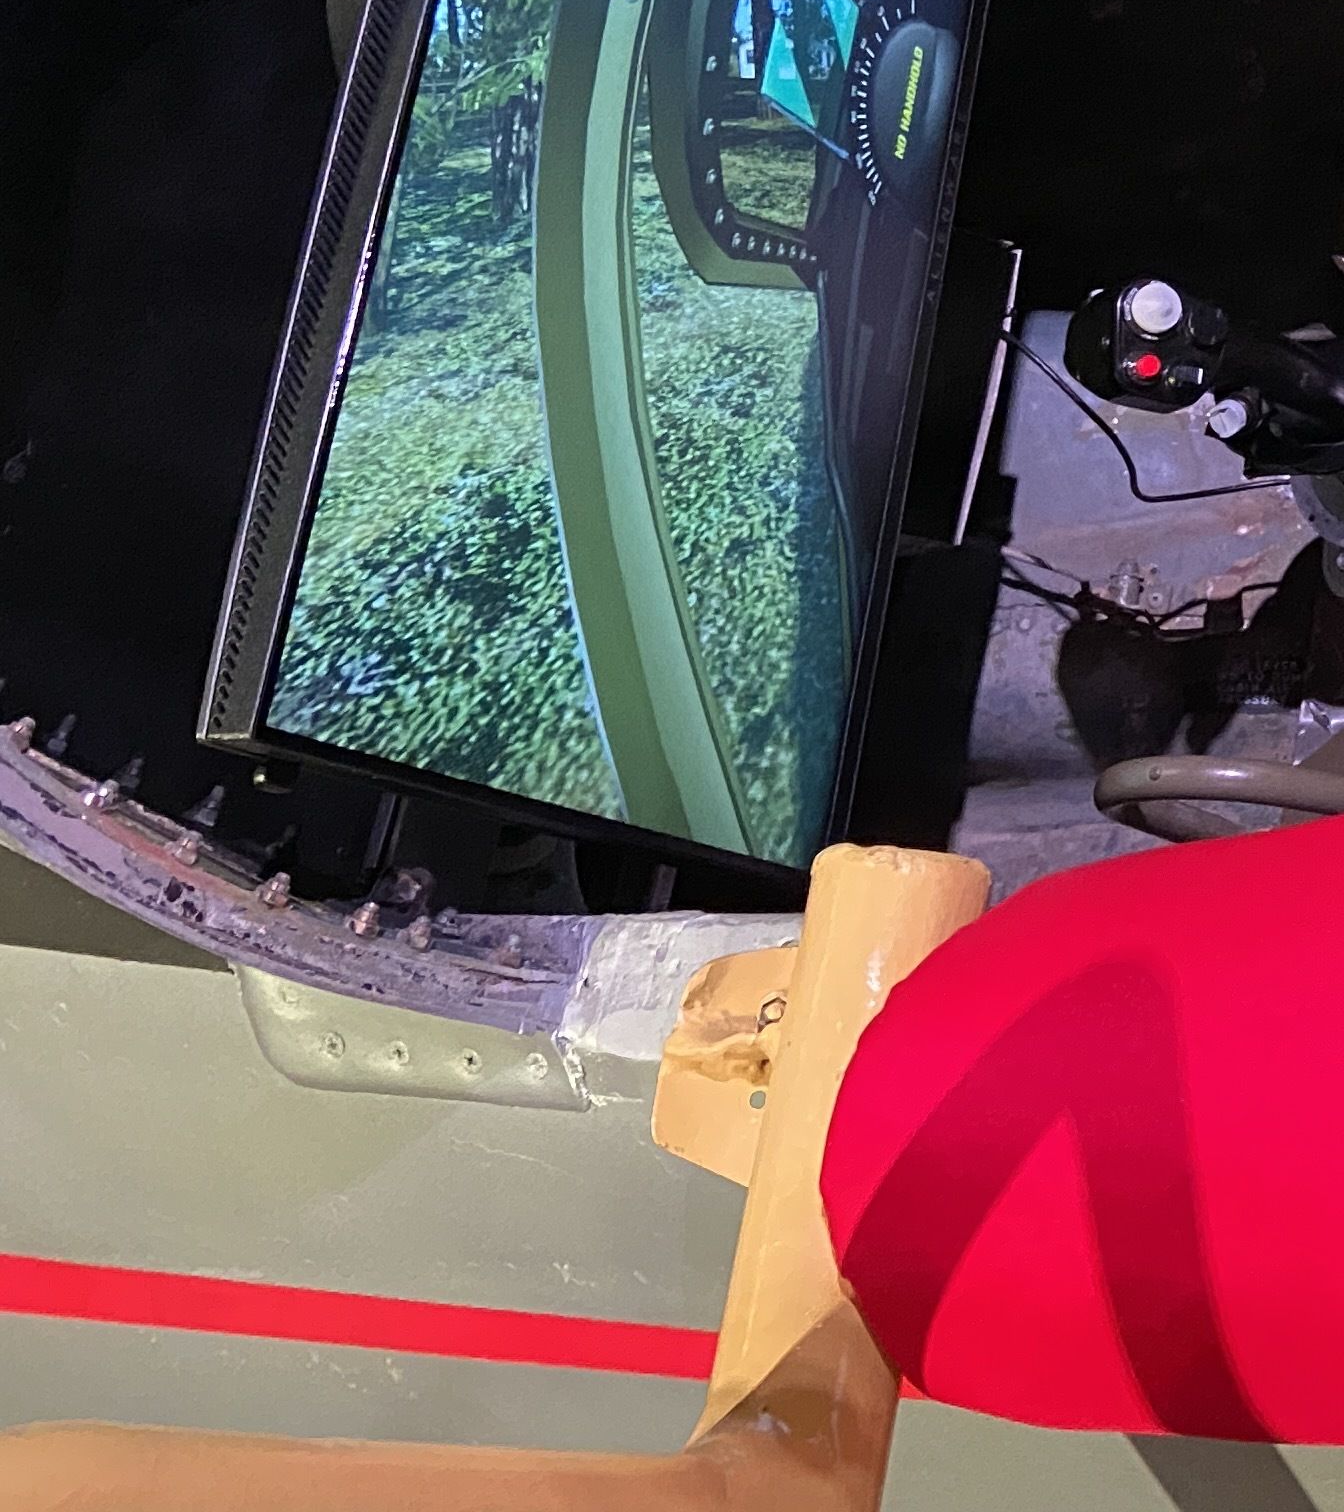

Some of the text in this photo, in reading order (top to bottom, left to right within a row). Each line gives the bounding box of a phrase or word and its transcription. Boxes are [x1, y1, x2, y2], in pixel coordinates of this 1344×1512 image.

[894, 45, 924, 160] NO HANDHOLD
[926, 111, 968, 301] ALIENWARE
